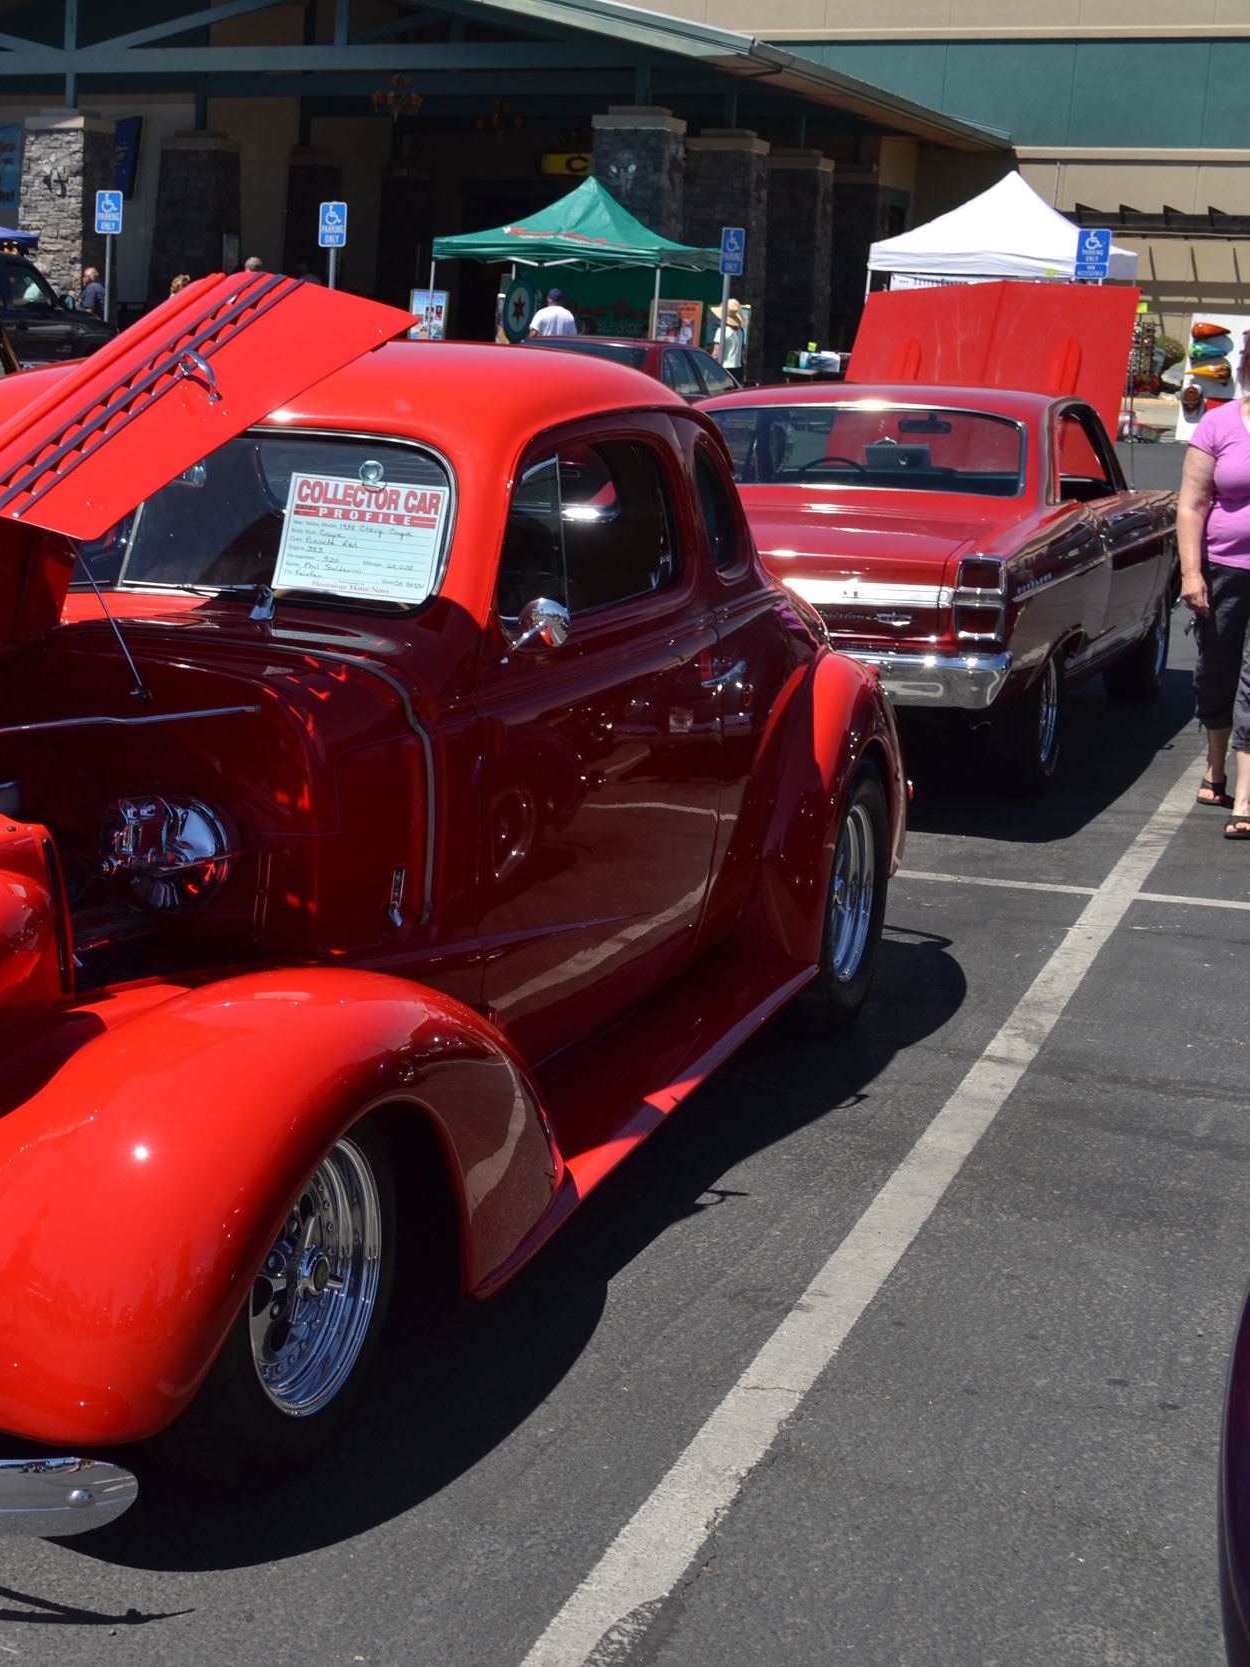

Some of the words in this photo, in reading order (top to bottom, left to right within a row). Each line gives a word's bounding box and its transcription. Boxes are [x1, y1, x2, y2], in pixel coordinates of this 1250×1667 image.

[98, 212, 120, 221] PARKING
[101, 221, 115, 230] ONLY
[322, 225, 344, 234] PARKING
[324, 234, 340, 243] ONLY
[1082, 249, 1104, 257] PARKING
[298, 479, 401, 511] COLLECTOR
[403, 490, 442, 515] CAR
[318, 507, 412, 526] PROFILE
[312, 581, 347, 590] Hemmings
[349, 584, 369, 592] Motor
